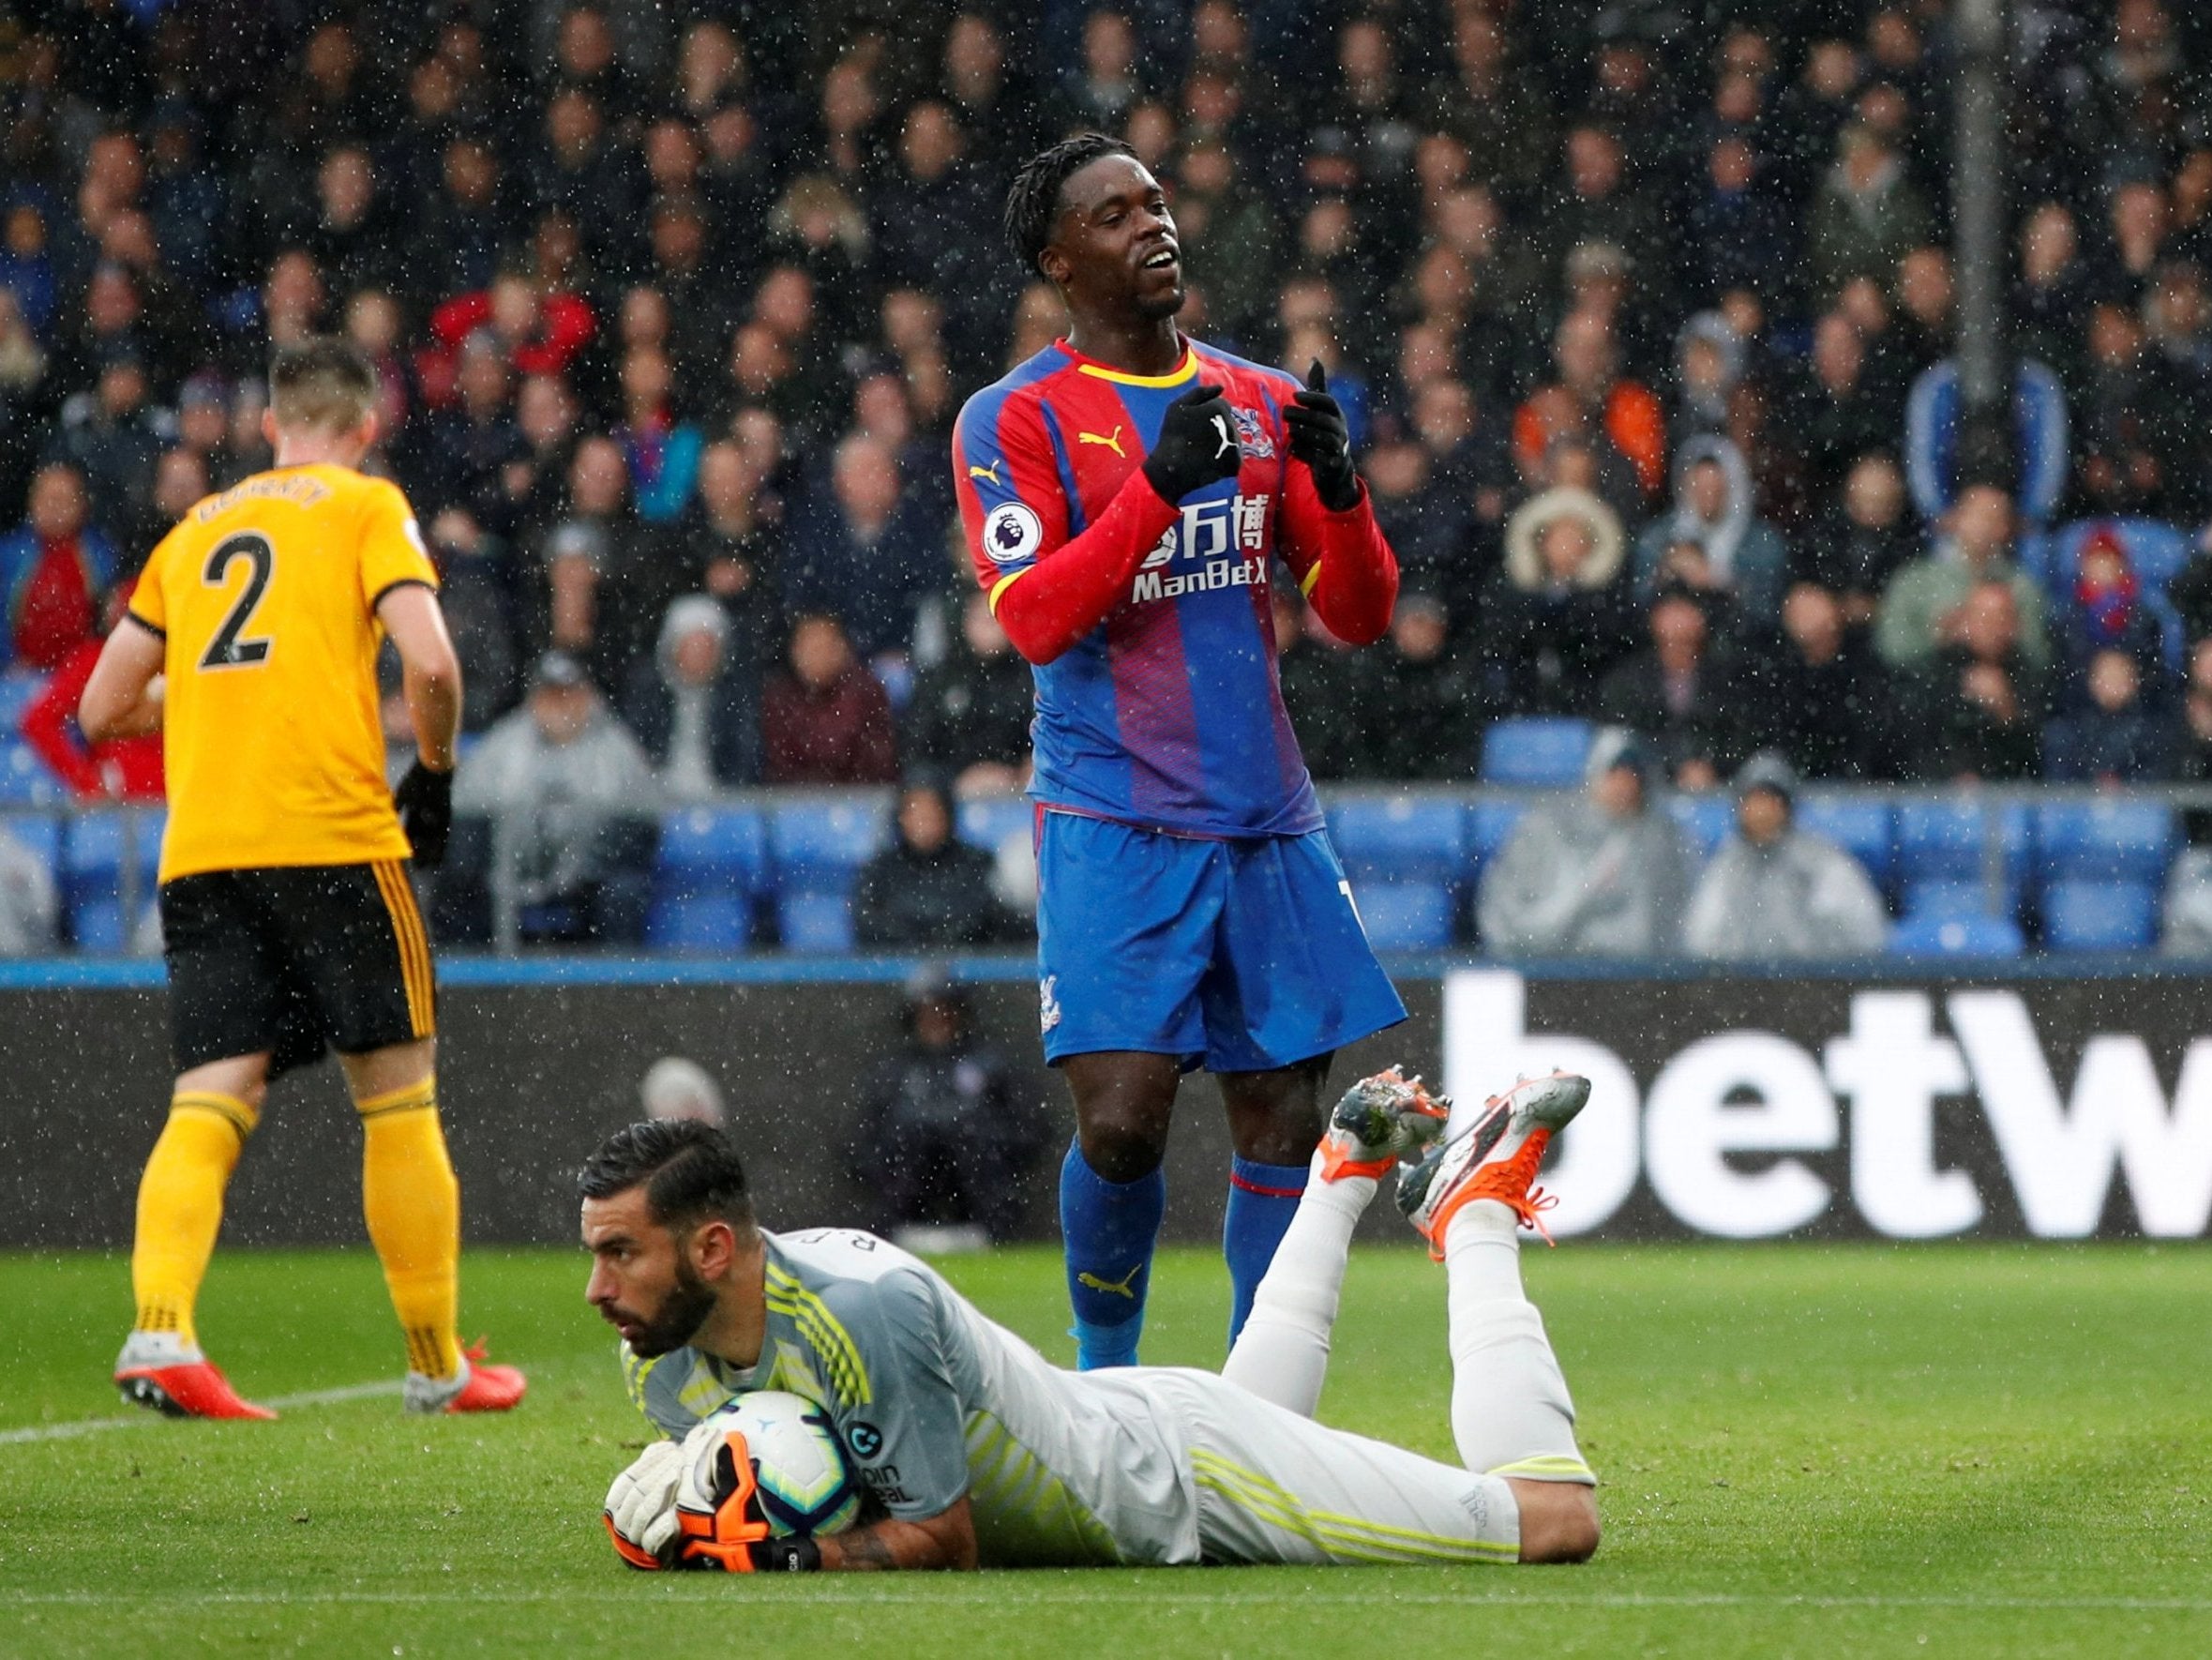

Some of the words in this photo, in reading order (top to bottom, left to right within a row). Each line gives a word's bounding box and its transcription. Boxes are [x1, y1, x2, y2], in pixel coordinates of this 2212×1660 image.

[1179, 493, 1270, 560] 万博
[199, 529, 275, 672] 2
[1131, 556, 1267, 604] ManBetX
